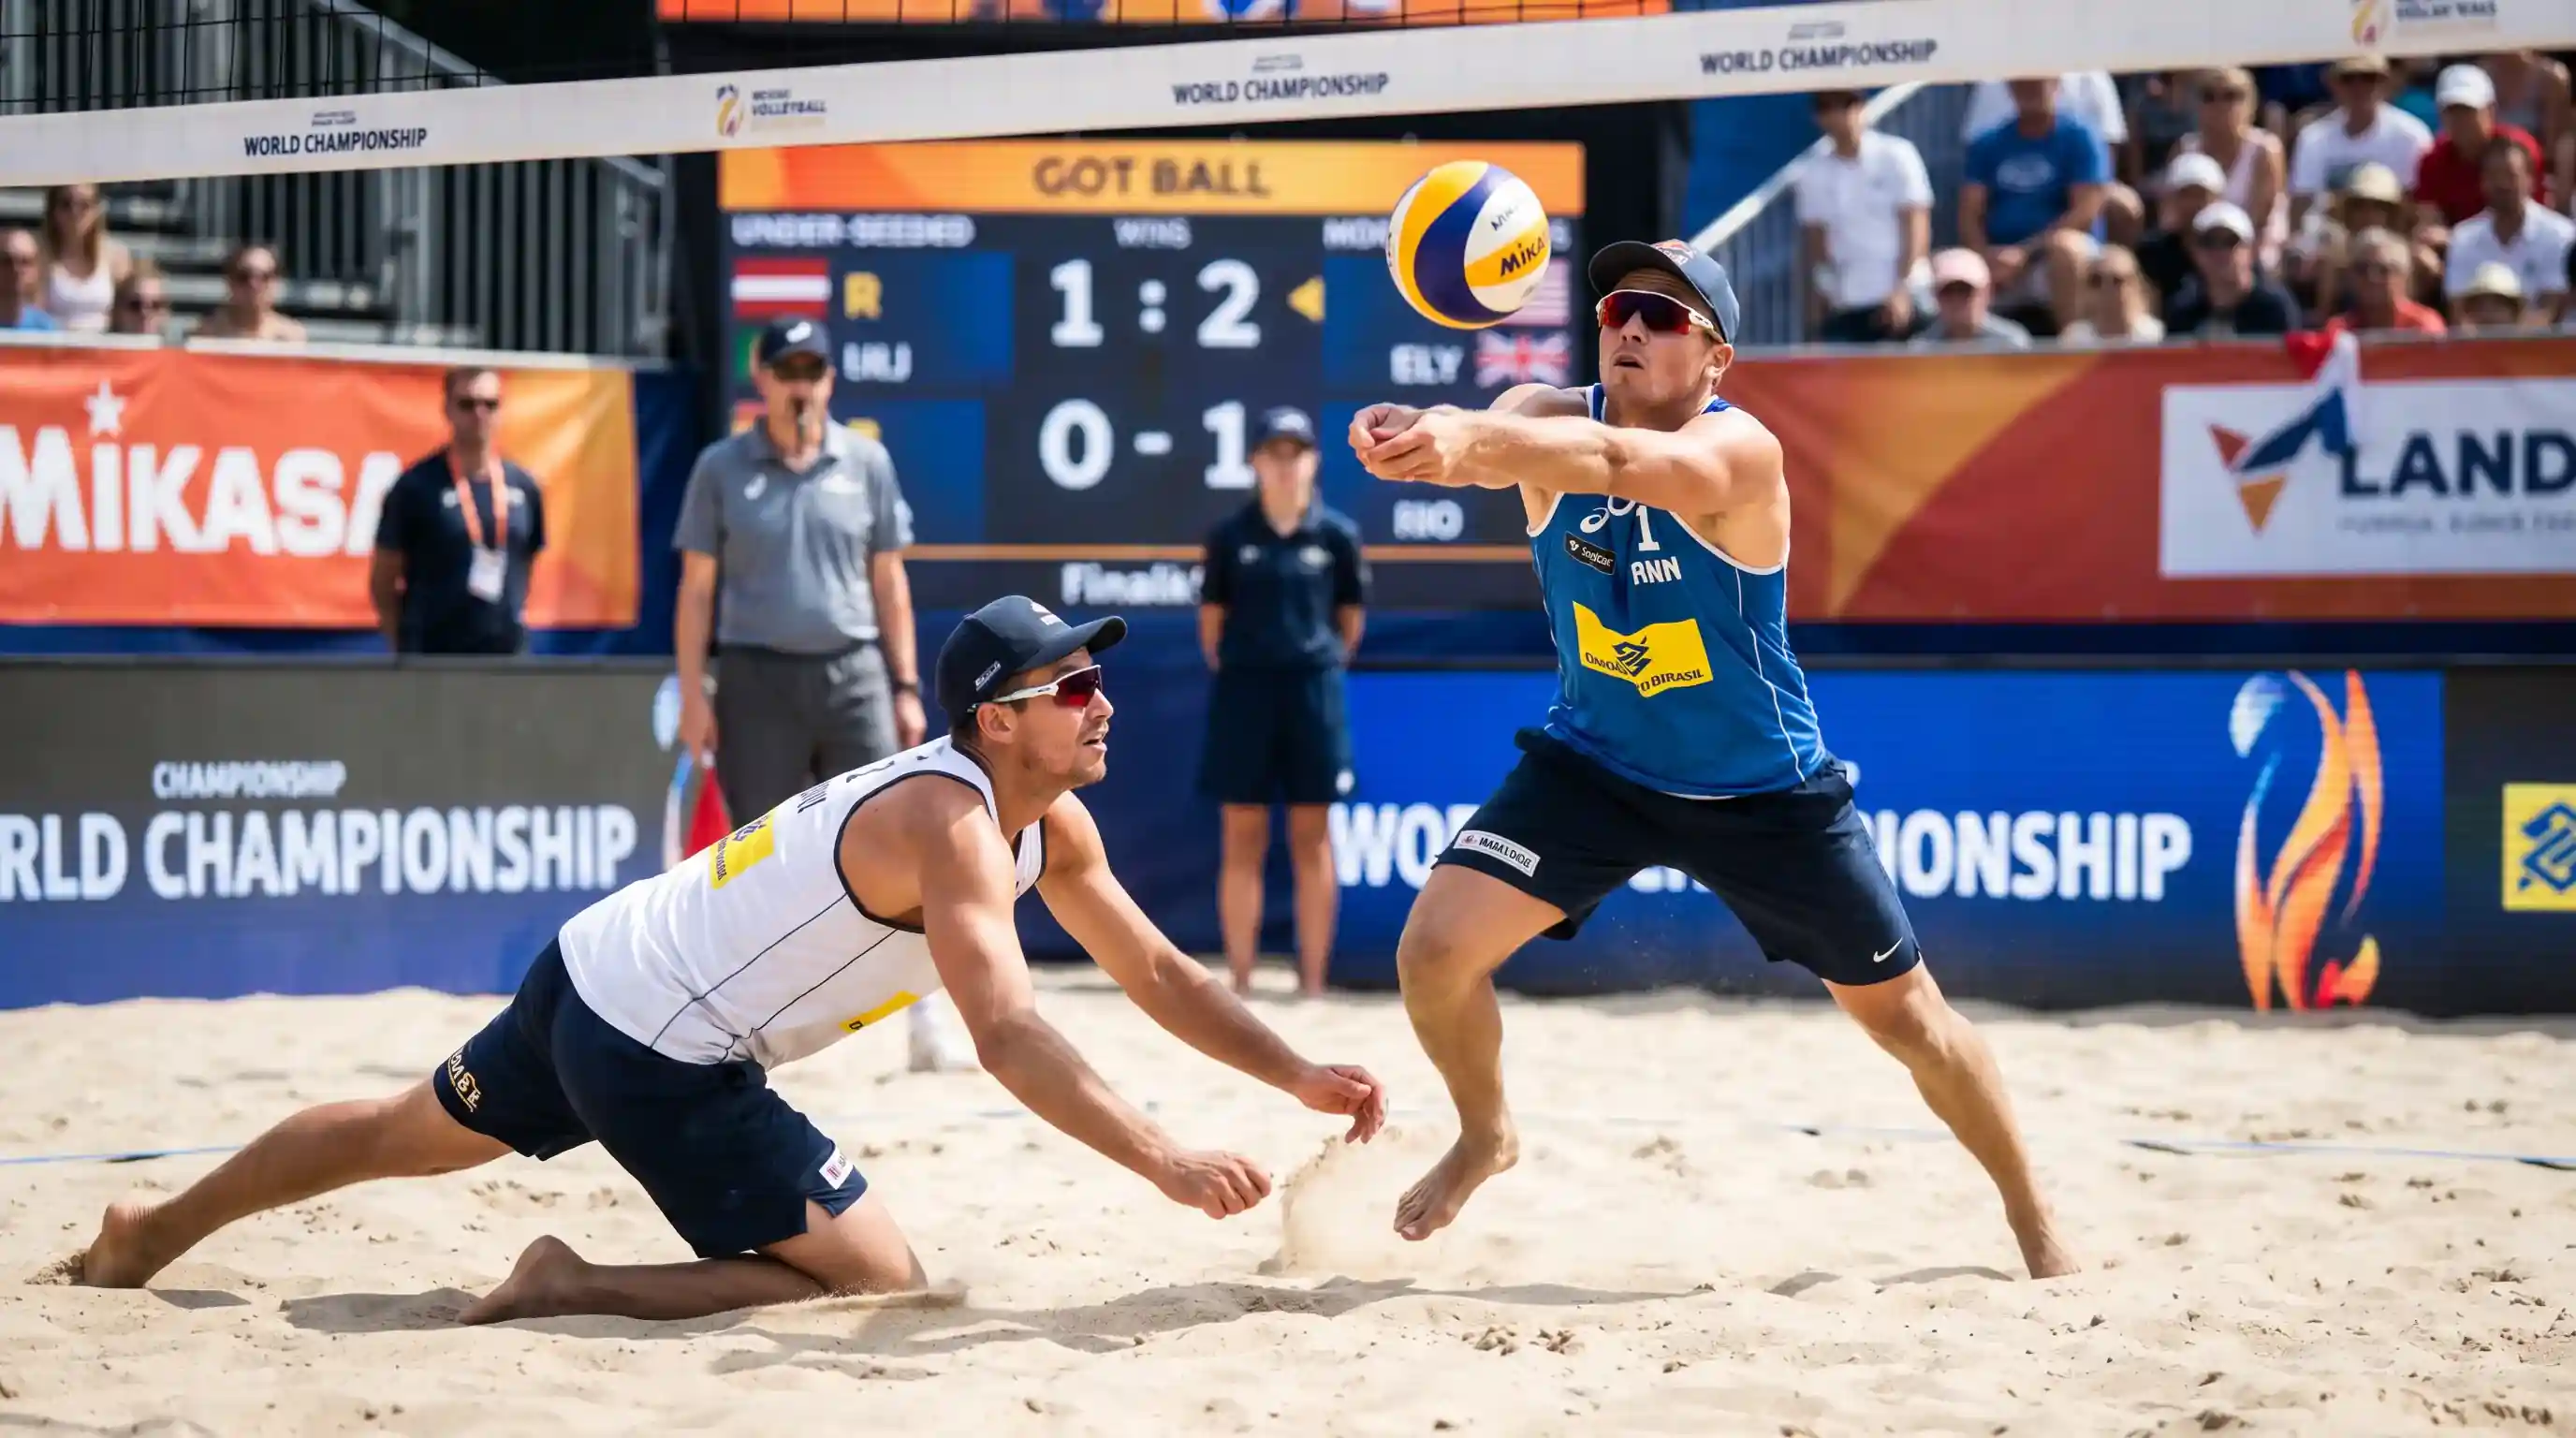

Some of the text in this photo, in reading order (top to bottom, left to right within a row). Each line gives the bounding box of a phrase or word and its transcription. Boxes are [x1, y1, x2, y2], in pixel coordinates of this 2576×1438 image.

[1700, 38, 1938, 75] WORLD CHAMPIONSHIP
[1173, 72, 1389, 104] WORLD CHAMPIONSHIP
[244, 127, 428, 157] WORLD CHAMPIONSHIP
[1049, 258, 1104, 347] 1
[1196, 258, 1261, 348] 2
[1038, 398, 1115, 491] 0
[1202, 400, 1257, 489] 1
[1635, 505, 1661, 551] 1
[1631, 556, 1682, 585] ANN
[153, 760, 346, 799] CHAMPIONSHIP
[144, 804, 638, 899] CHAMPIONSHIP
